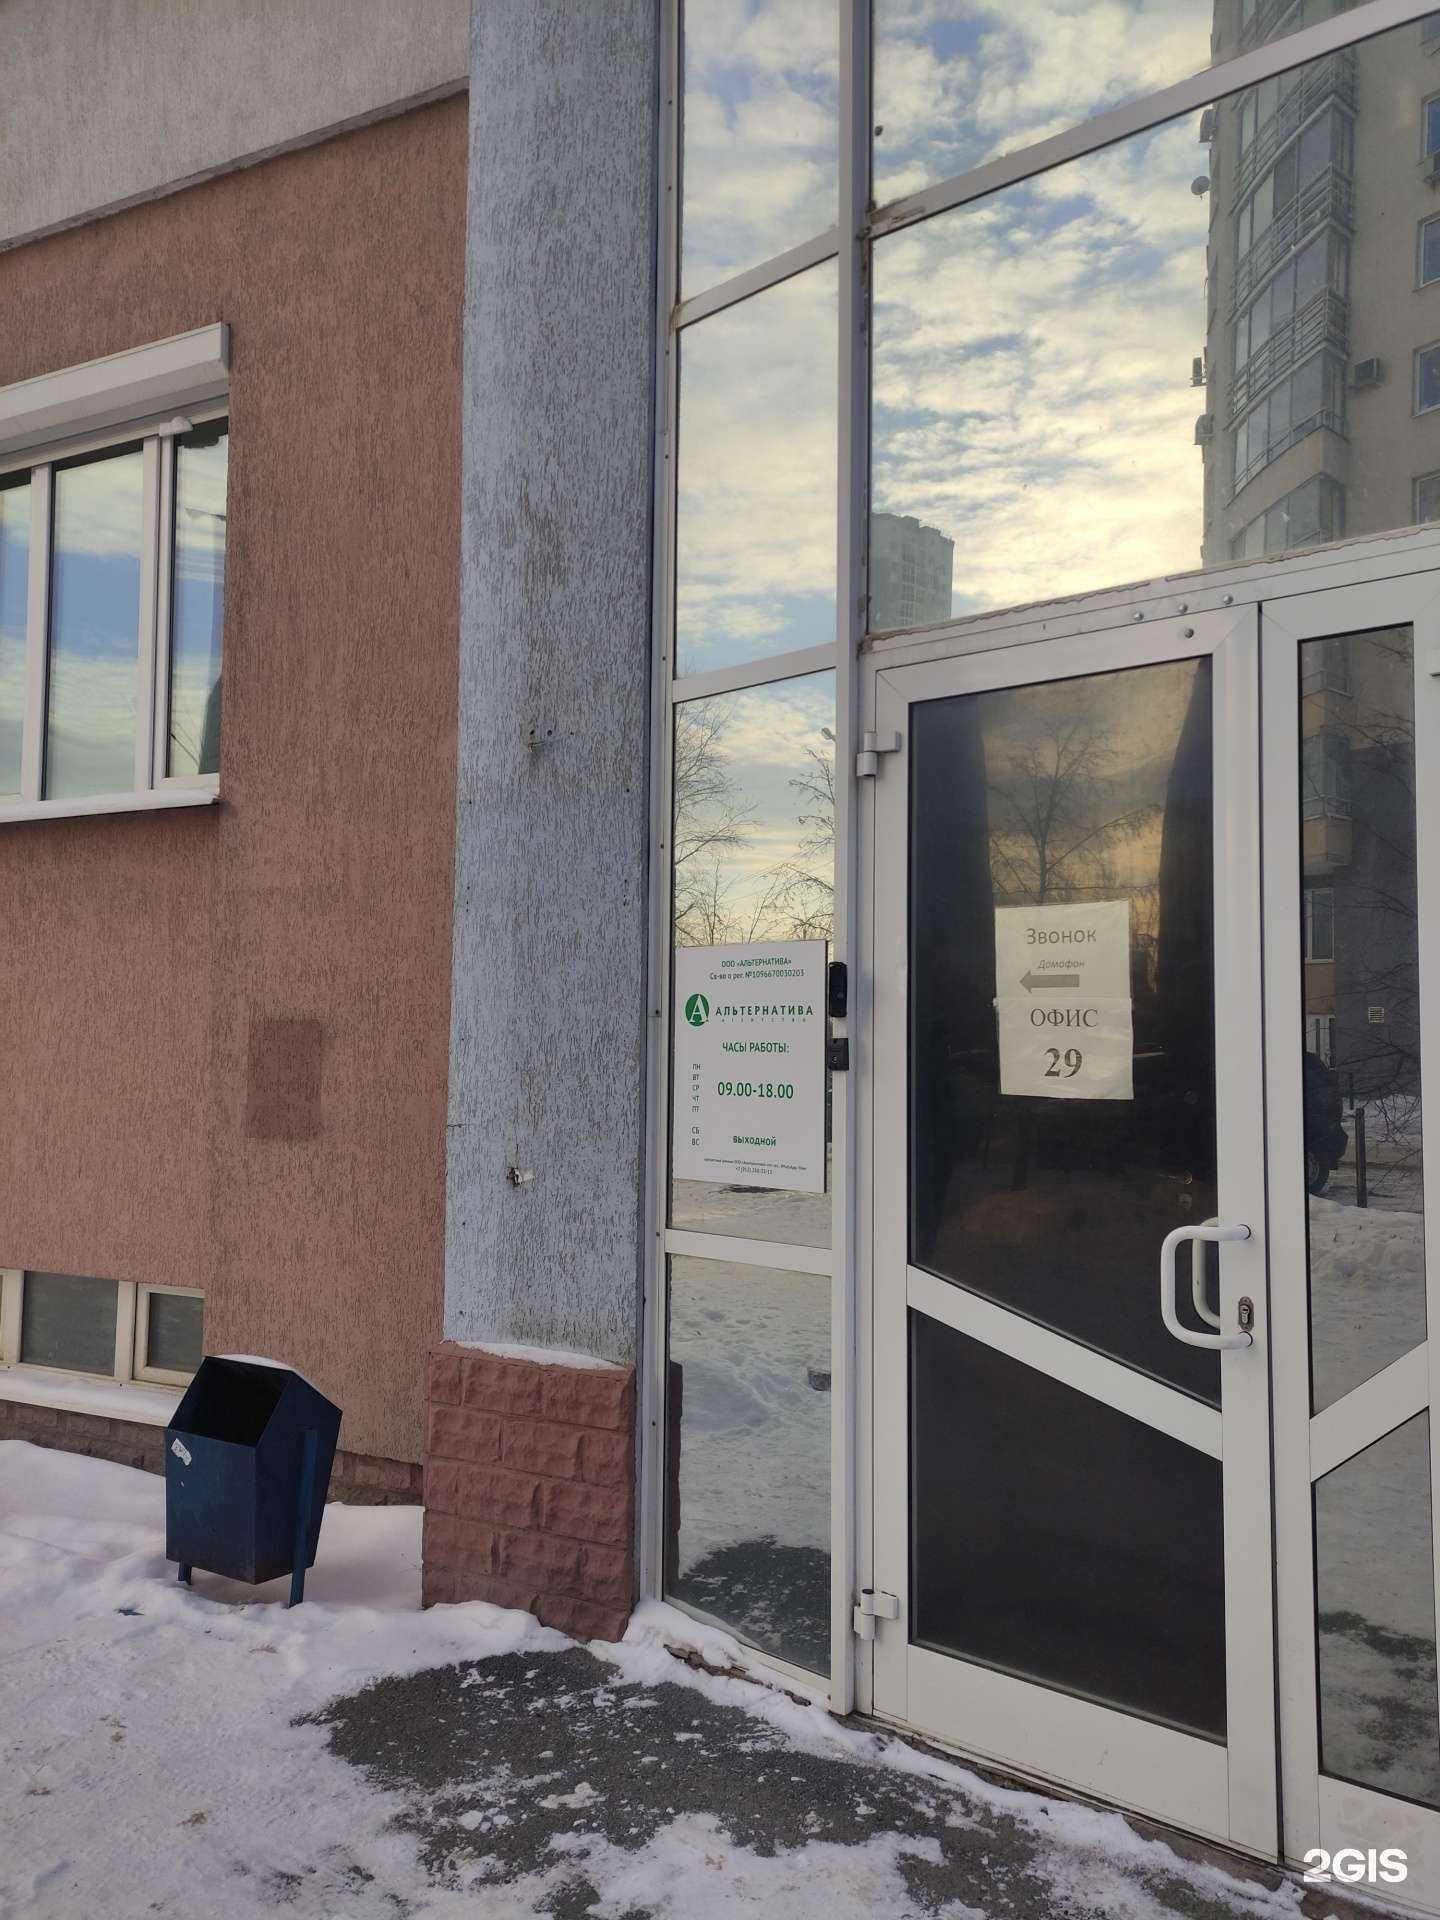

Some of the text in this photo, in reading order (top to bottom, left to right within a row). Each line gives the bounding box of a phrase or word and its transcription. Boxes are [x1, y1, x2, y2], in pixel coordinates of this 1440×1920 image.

[1027, 929, 1096, 944] Звонок
[737, 958, 792, 966] «АЛЬТЕРНАТИВА»
[1038, 959, 1084, 970] Домофон
[716, 1005, 813, 1016] АЛЬТЕРНАТИВА
[1030, 1008, 1098, 1027] ОФИС
[722, 1042, 790, 1054] ЧАСЫ РАБОТЫ:
[1044, 1048, 1083, 1078] 29
[718, 1082, 794, 1099] 09.00-18.00
[691, 1126, 700, 1135] СБ
[692, 1138, 700, 1146] ВС
